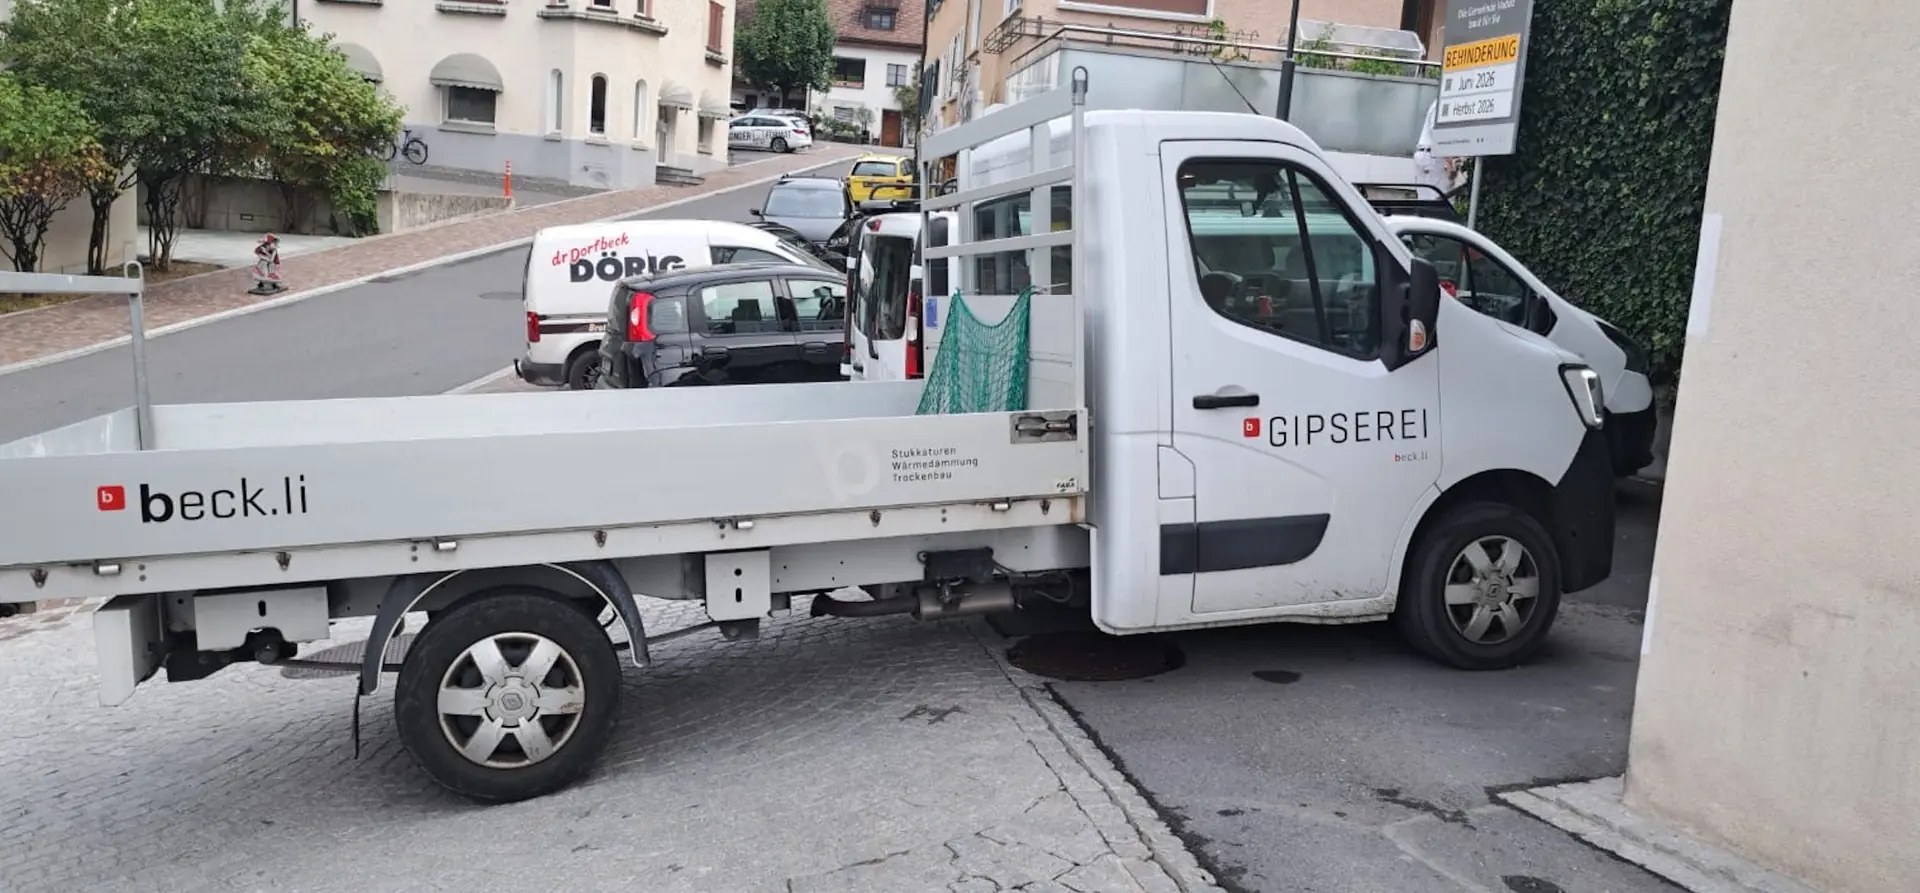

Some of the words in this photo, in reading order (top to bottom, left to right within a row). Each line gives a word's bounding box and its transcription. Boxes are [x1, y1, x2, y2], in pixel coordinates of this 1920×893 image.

[1445, 40, 1517, 68] BEHINDERUNG
[1458, 75, 1474, 91] Juni
[1475, 71, 1496, 89] 2026
[1452, 101, 1476, 116] Herbst
[551, 249, 569, 266] dr
[570, 232, 630, 263] Dorfbeck
[570, 251, 686, 282] DÖRIG
[1269, 408, 1428, 447] GIPSEREI
[891, 446, 957, 459] Stukkaturen
[1394, 450, 1429, 462] beck.li
[892, 470, 953, 482] Trockenbau
[139, 474, 307, 524] beck.li
